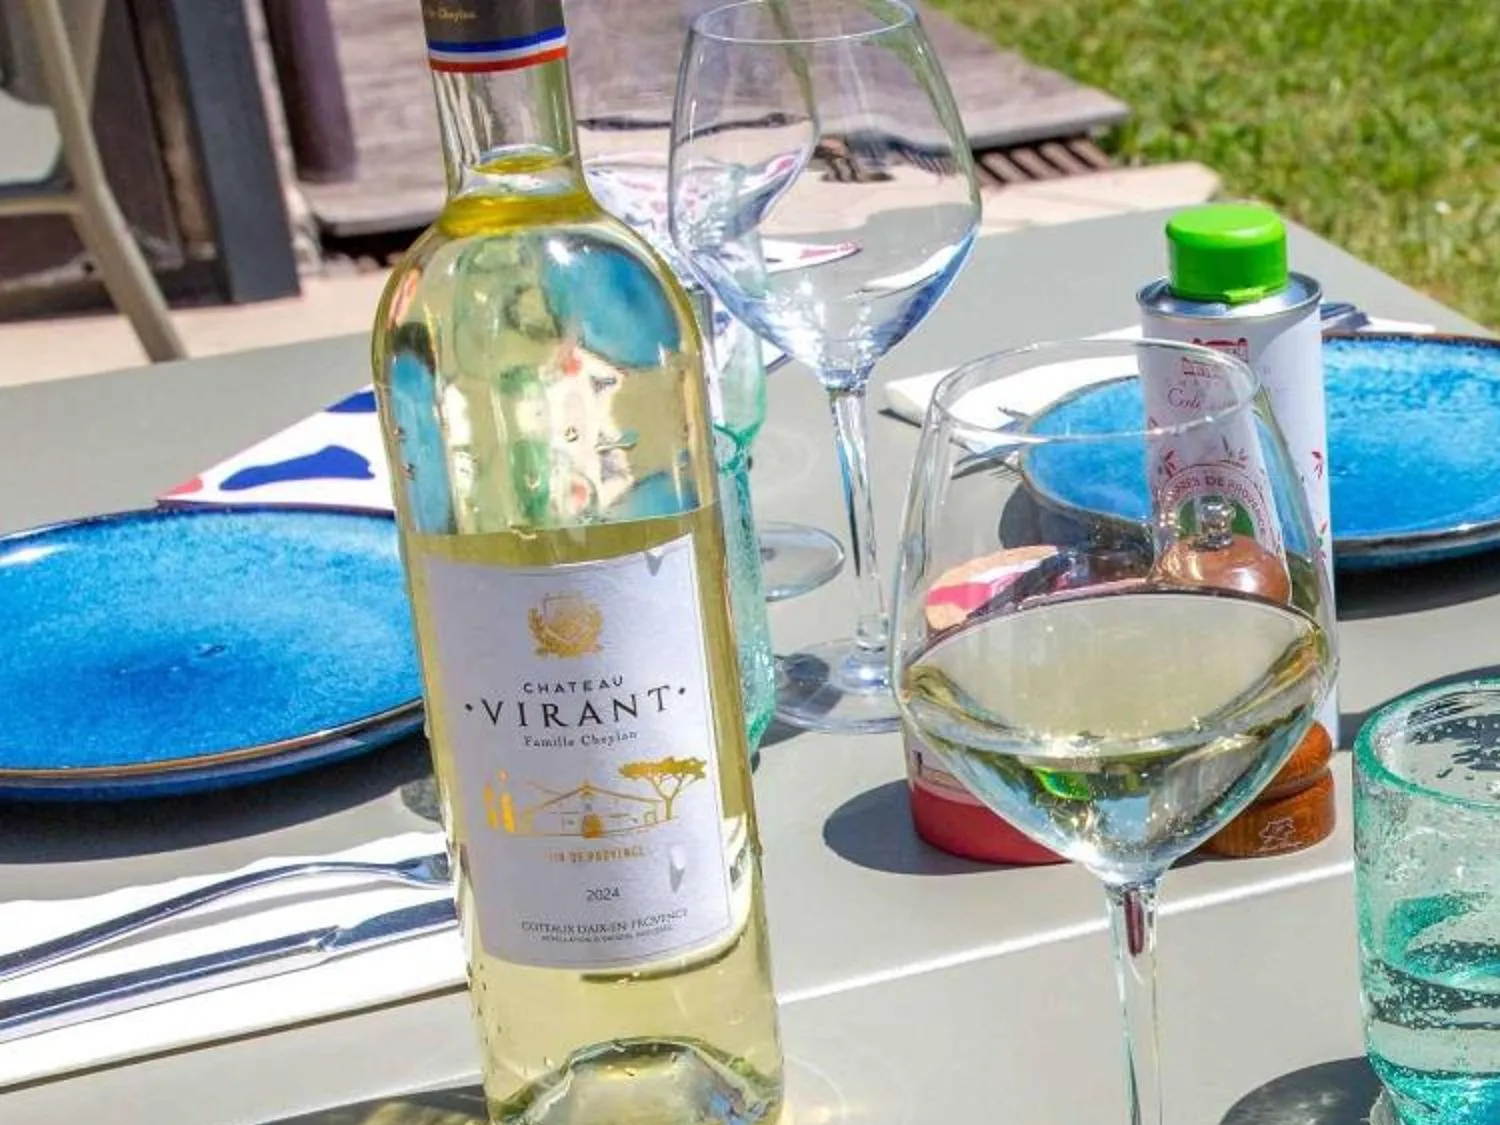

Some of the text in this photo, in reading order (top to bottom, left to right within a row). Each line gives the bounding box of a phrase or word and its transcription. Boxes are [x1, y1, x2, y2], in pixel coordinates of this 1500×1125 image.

[523, 675, 624, 695] CHATEAU
[524, 735, 575, 749] Famille
[585, 886, 621, 901] 2024
